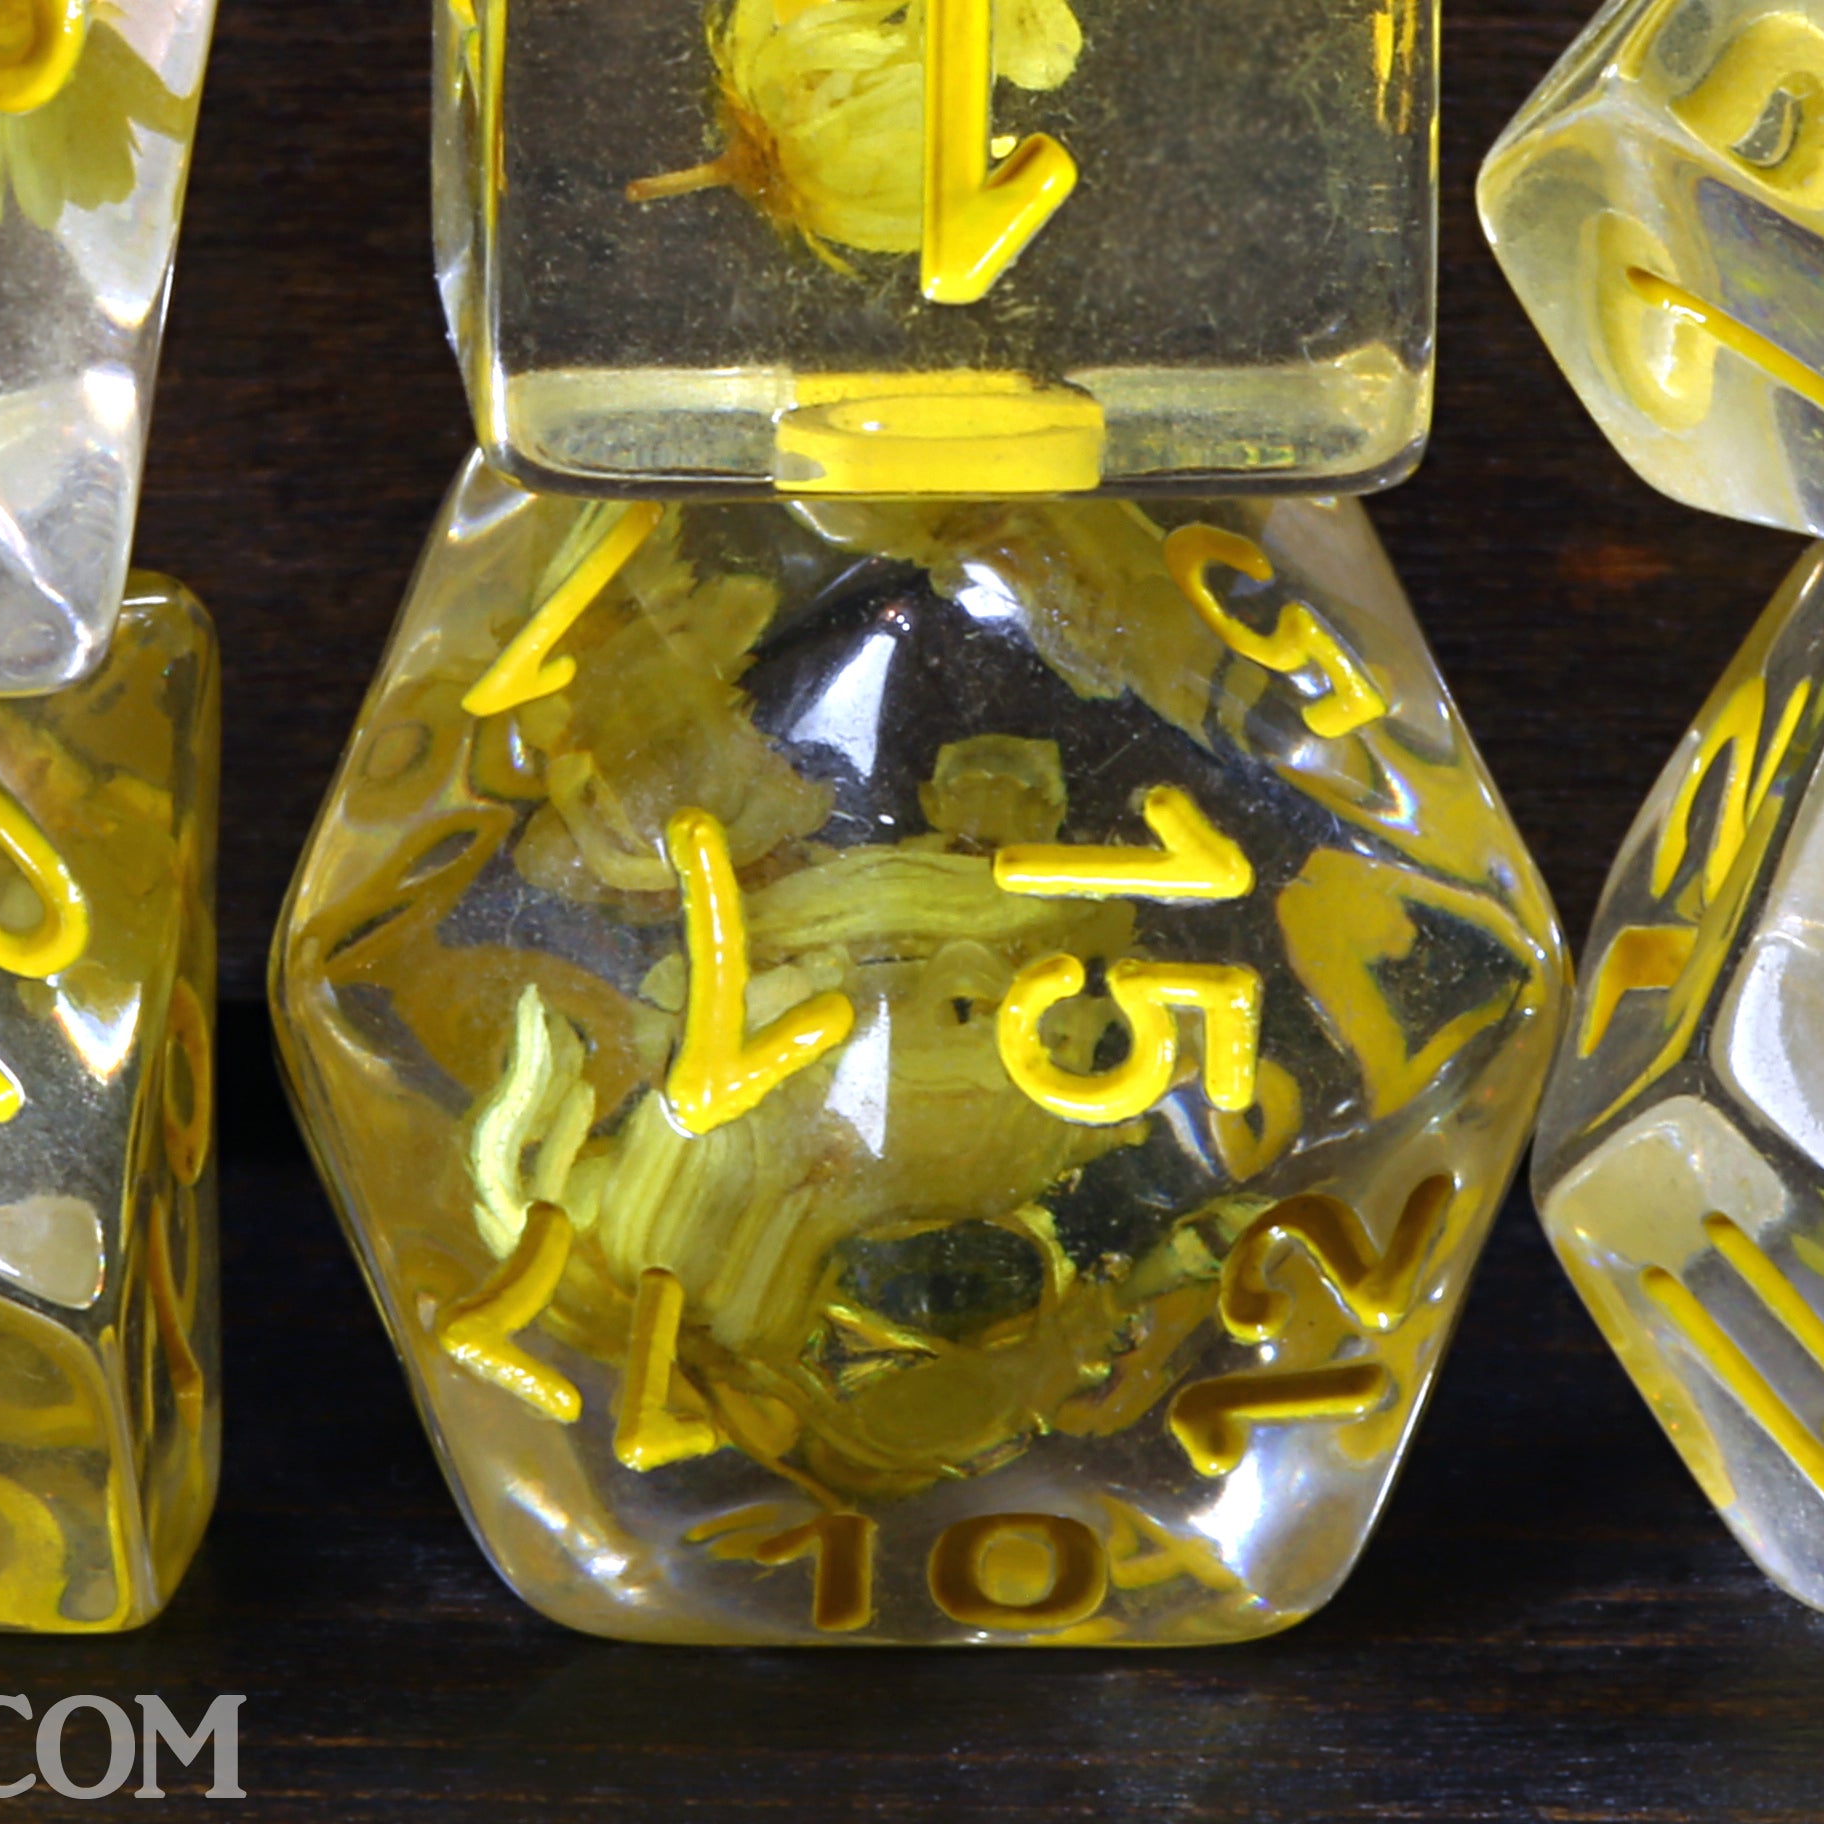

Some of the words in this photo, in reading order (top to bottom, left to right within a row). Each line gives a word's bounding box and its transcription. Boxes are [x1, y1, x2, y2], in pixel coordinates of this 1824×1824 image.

[993, 785, 1261, 1122] 15
[1171, 1175, 1455, 1475] 12
[758, 1512, 1107, 1630] 10
